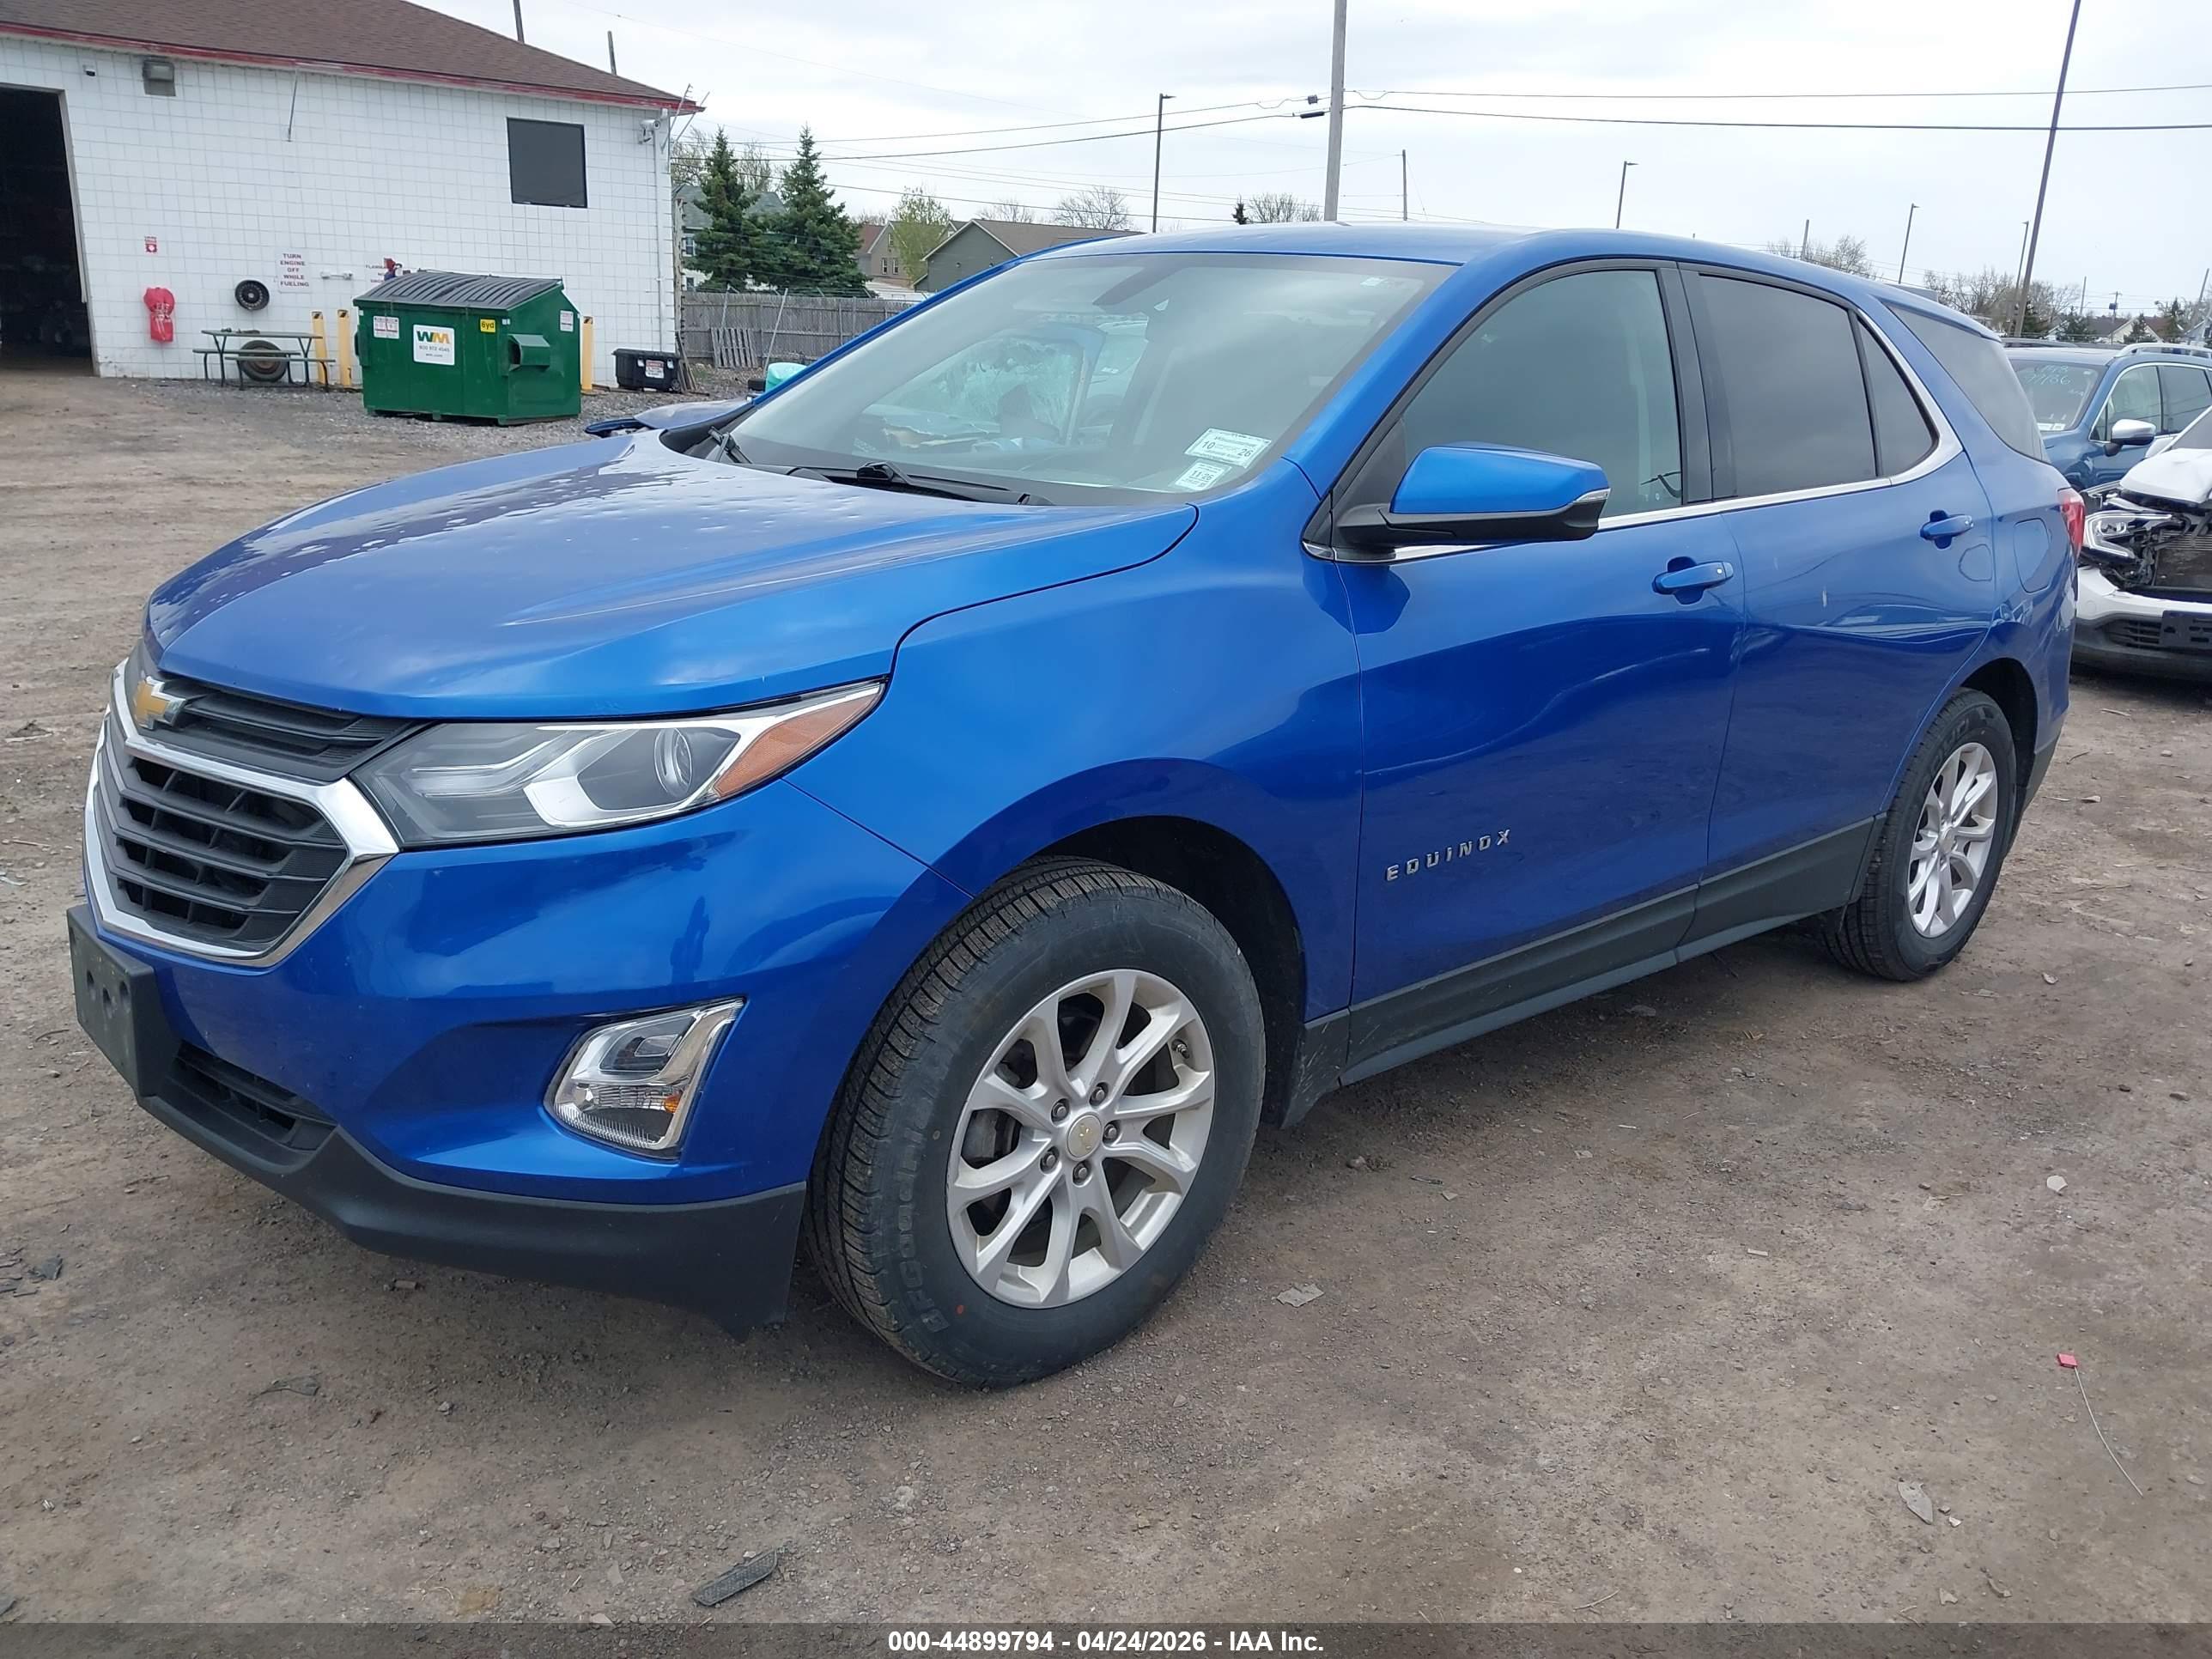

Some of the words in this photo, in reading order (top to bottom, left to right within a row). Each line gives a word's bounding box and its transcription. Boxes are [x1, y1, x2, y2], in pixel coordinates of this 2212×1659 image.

[481, 320, 495, 330] 6yd
[416, 331, 450, 344] WM
[1201, 441, 1215, 450] 10
[1237, 448, 1254, 458] 26
[1386, 829, 1510, 881] EQUINOX
